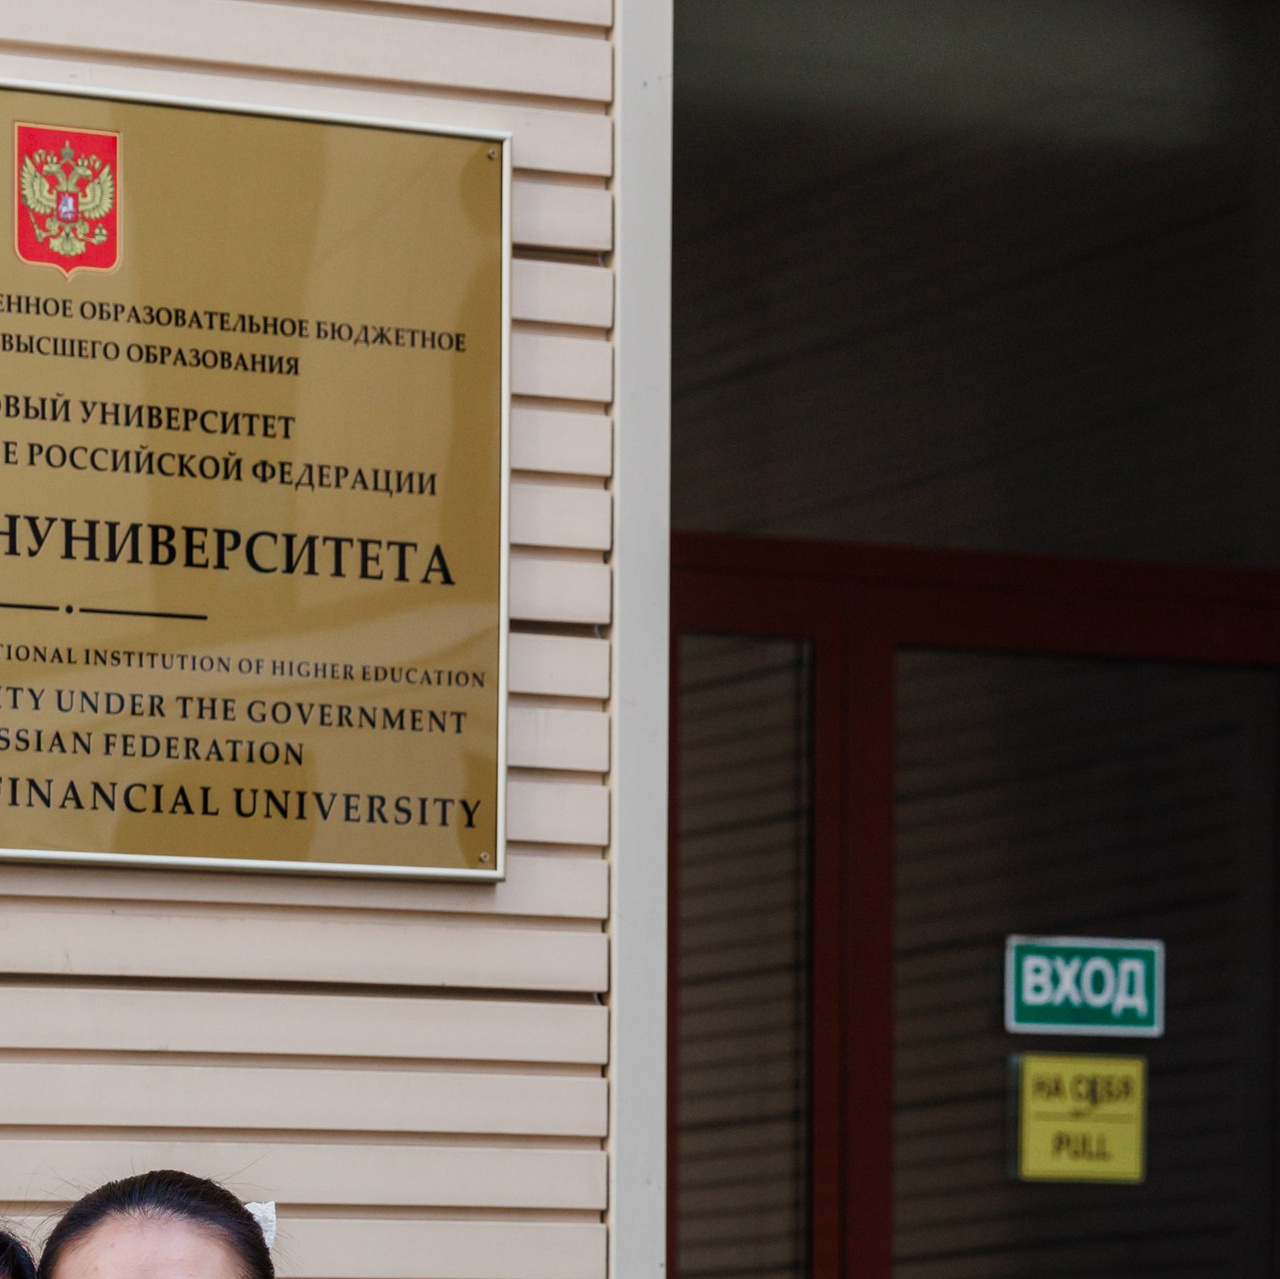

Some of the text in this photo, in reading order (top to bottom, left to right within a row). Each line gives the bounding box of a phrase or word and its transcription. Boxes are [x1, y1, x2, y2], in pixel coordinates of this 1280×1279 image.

[79, 300, 309, 338] ОБРАЗОВАТЕЛЬНОЕ
[316, 320, 467, 353] БЮДЖЕТНОЕ
[0, 332, 121, 361] ВЫСШЕГО
[126, 343, 300, 377] ОБРАЗОВАНИЯ
[79, 399, 296, 440] УНИВЕРСИТЕТ
[27, 442, 243, 482] РОССИЙСКОЙ
[251, 459, 437, 498] ФЕДЕРАЦИИ
[83, 648, 230, 673] INSTITUTION
[237, 657, 267, 677] OF
[272, 660, 355, 681] HIGHER
[361, 665, 485, 688] EDUCATION
[55, 689, 166, 718] UNDER
[175, 695, 236, 722] THE
[246, 699, 468, 735] GOVERNMENT
[103, 733, 304, 767] FEDERATION
[232, 787, 482, 830] UNIVERSITY
[1022, 954, 1148, 1018] ВХОД
[1032, 1073, 1066, 1101] НА
[1051, 1130, 1112, 1161] PULL
